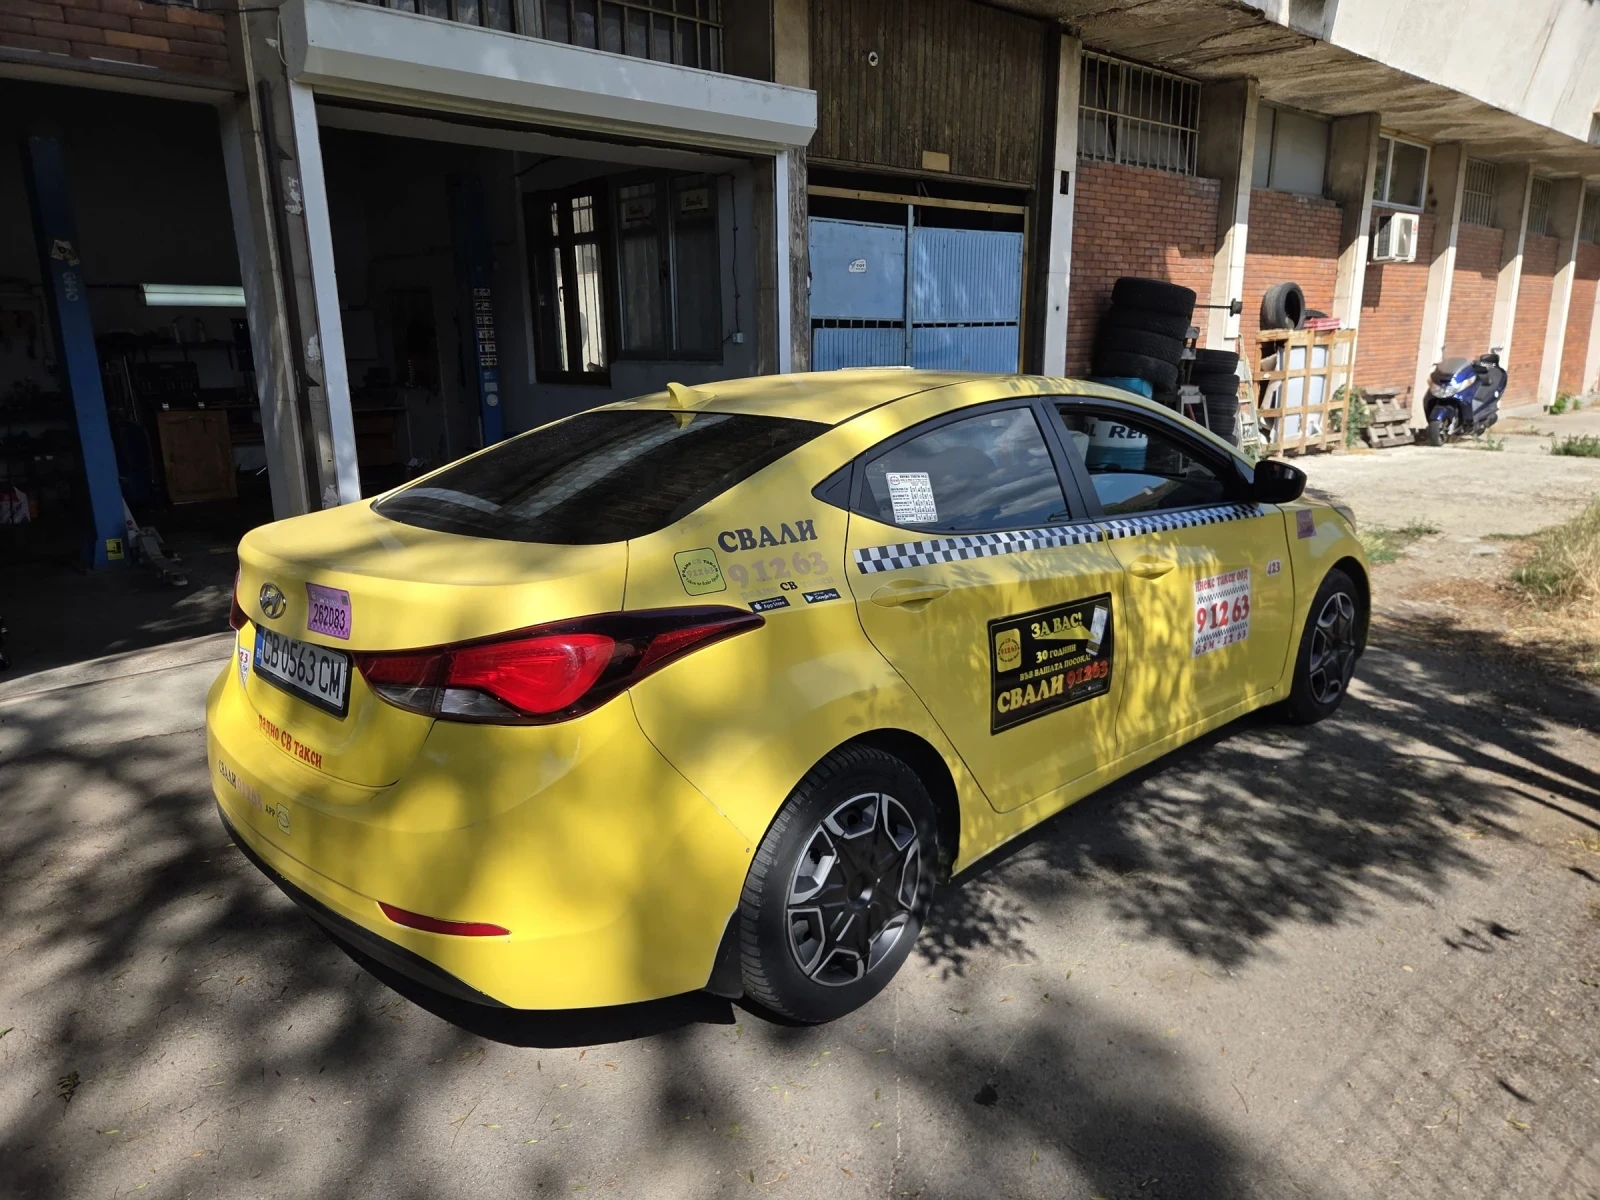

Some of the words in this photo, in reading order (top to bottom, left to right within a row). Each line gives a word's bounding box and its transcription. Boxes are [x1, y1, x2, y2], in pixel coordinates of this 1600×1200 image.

[717, 519, 818, 553] СВАЛИ
[312, 603, 346, 630] 262083
[1031, 621, 1051, 639] ЗА
[1052, 612, 1083, 633] ВАС!
[1036, 650, 1048, 663] 30
[1049, 644, 1077, 659] ГОДИНИ
[1019, 669, 1034, 681] ВЪВ
[1034, 663, 1063, 677] ВАШАТА
[997, 674, 1065, 713] СВАЛИ
[1066, 660, 1109, 689] 91263
